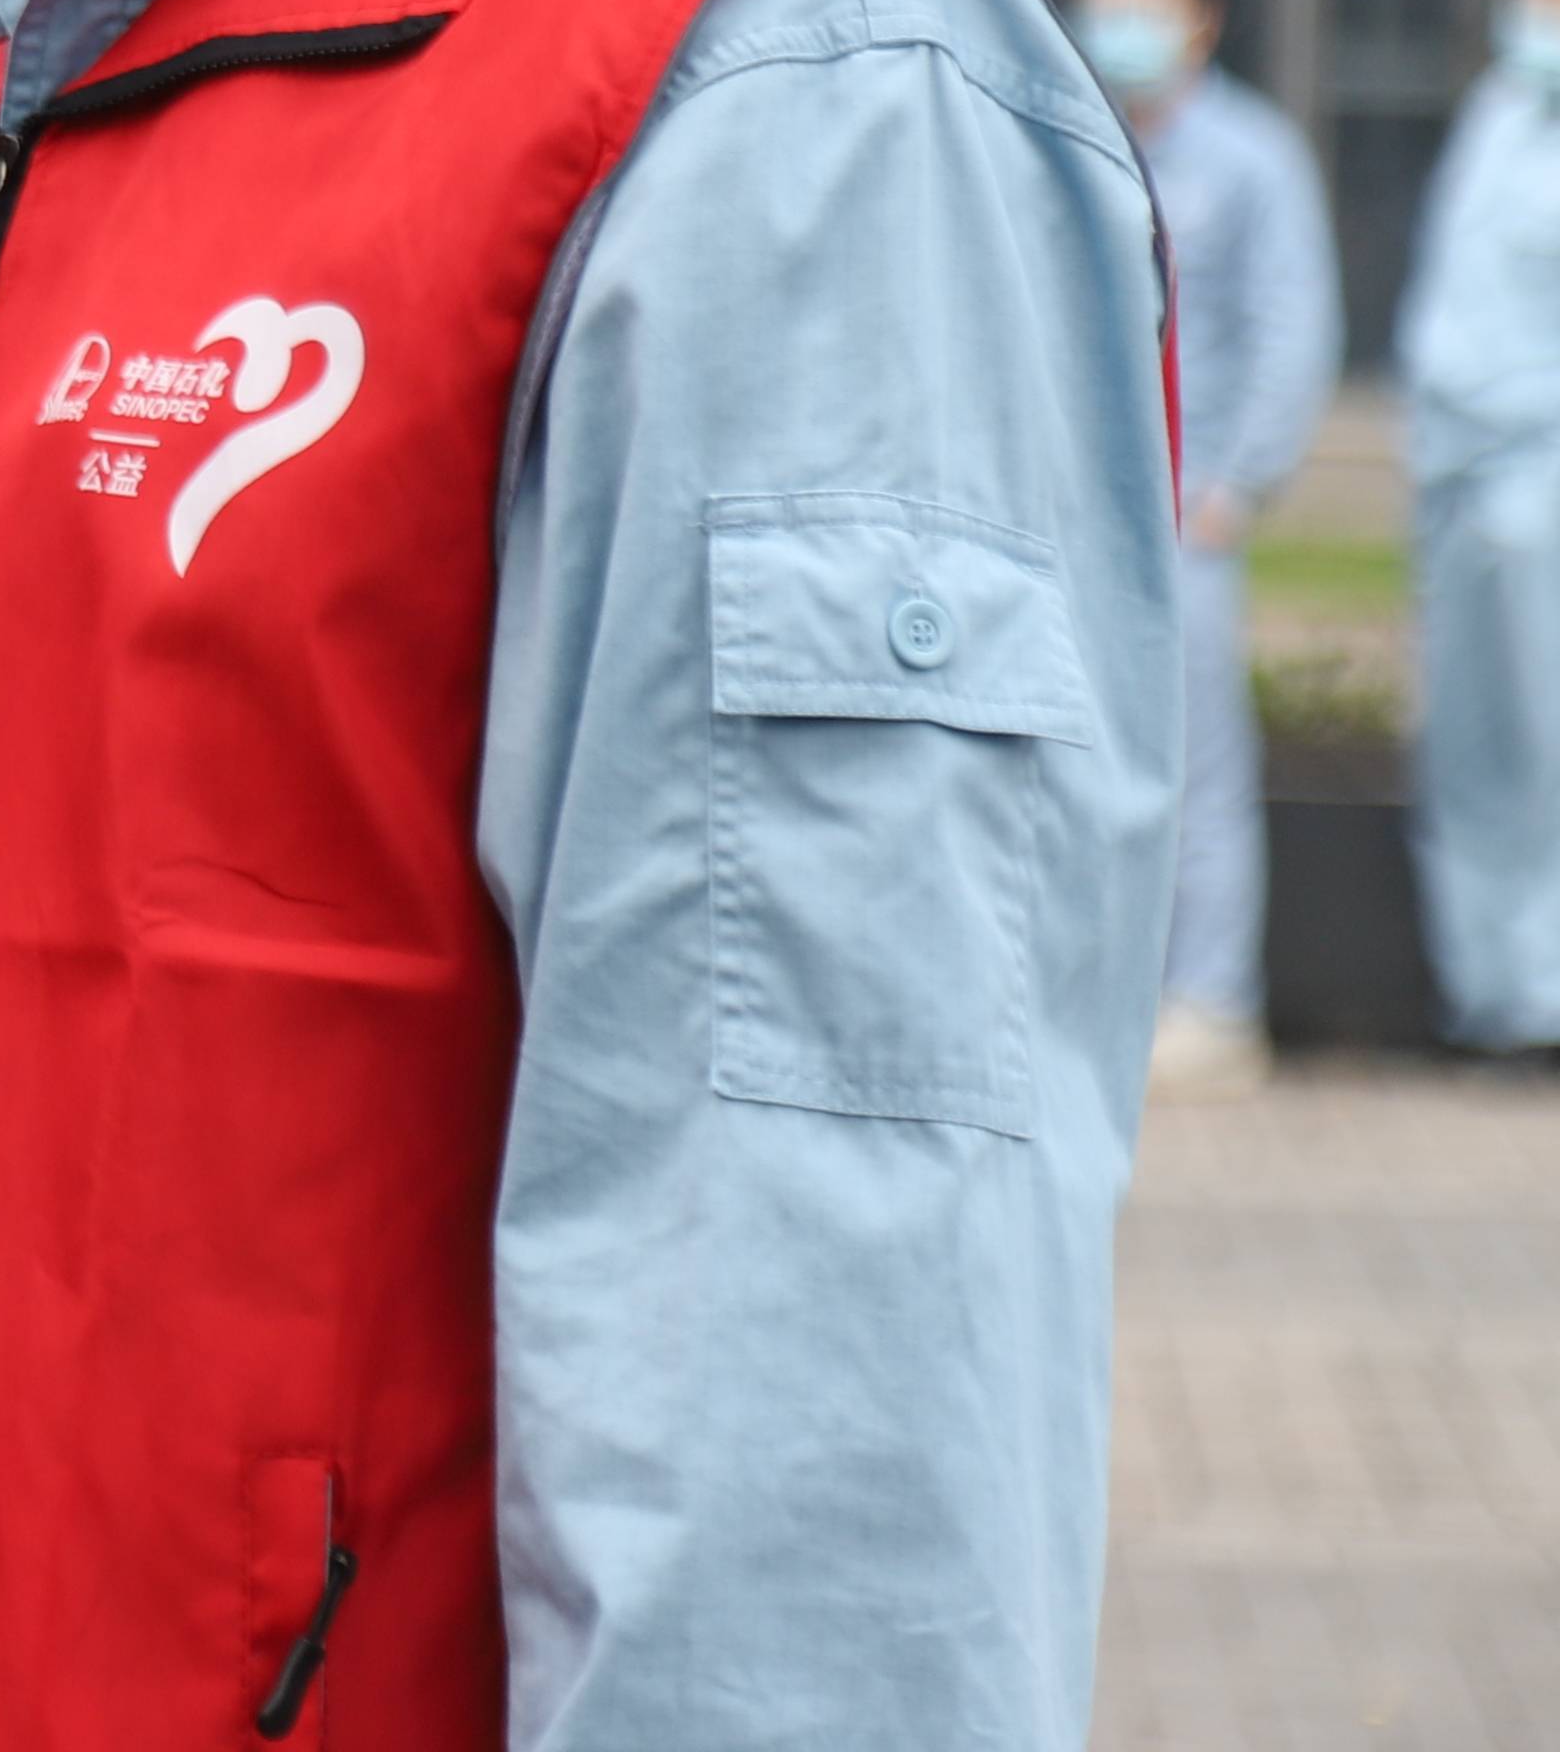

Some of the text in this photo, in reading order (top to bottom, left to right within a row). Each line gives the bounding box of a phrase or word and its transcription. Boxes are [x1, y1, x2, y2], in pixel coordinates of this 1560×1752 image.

[121, 355, 231, 398] 中国石化
[110, 393, 210, 424] SINOPEC
[78, 449, 148, 498] 公益
